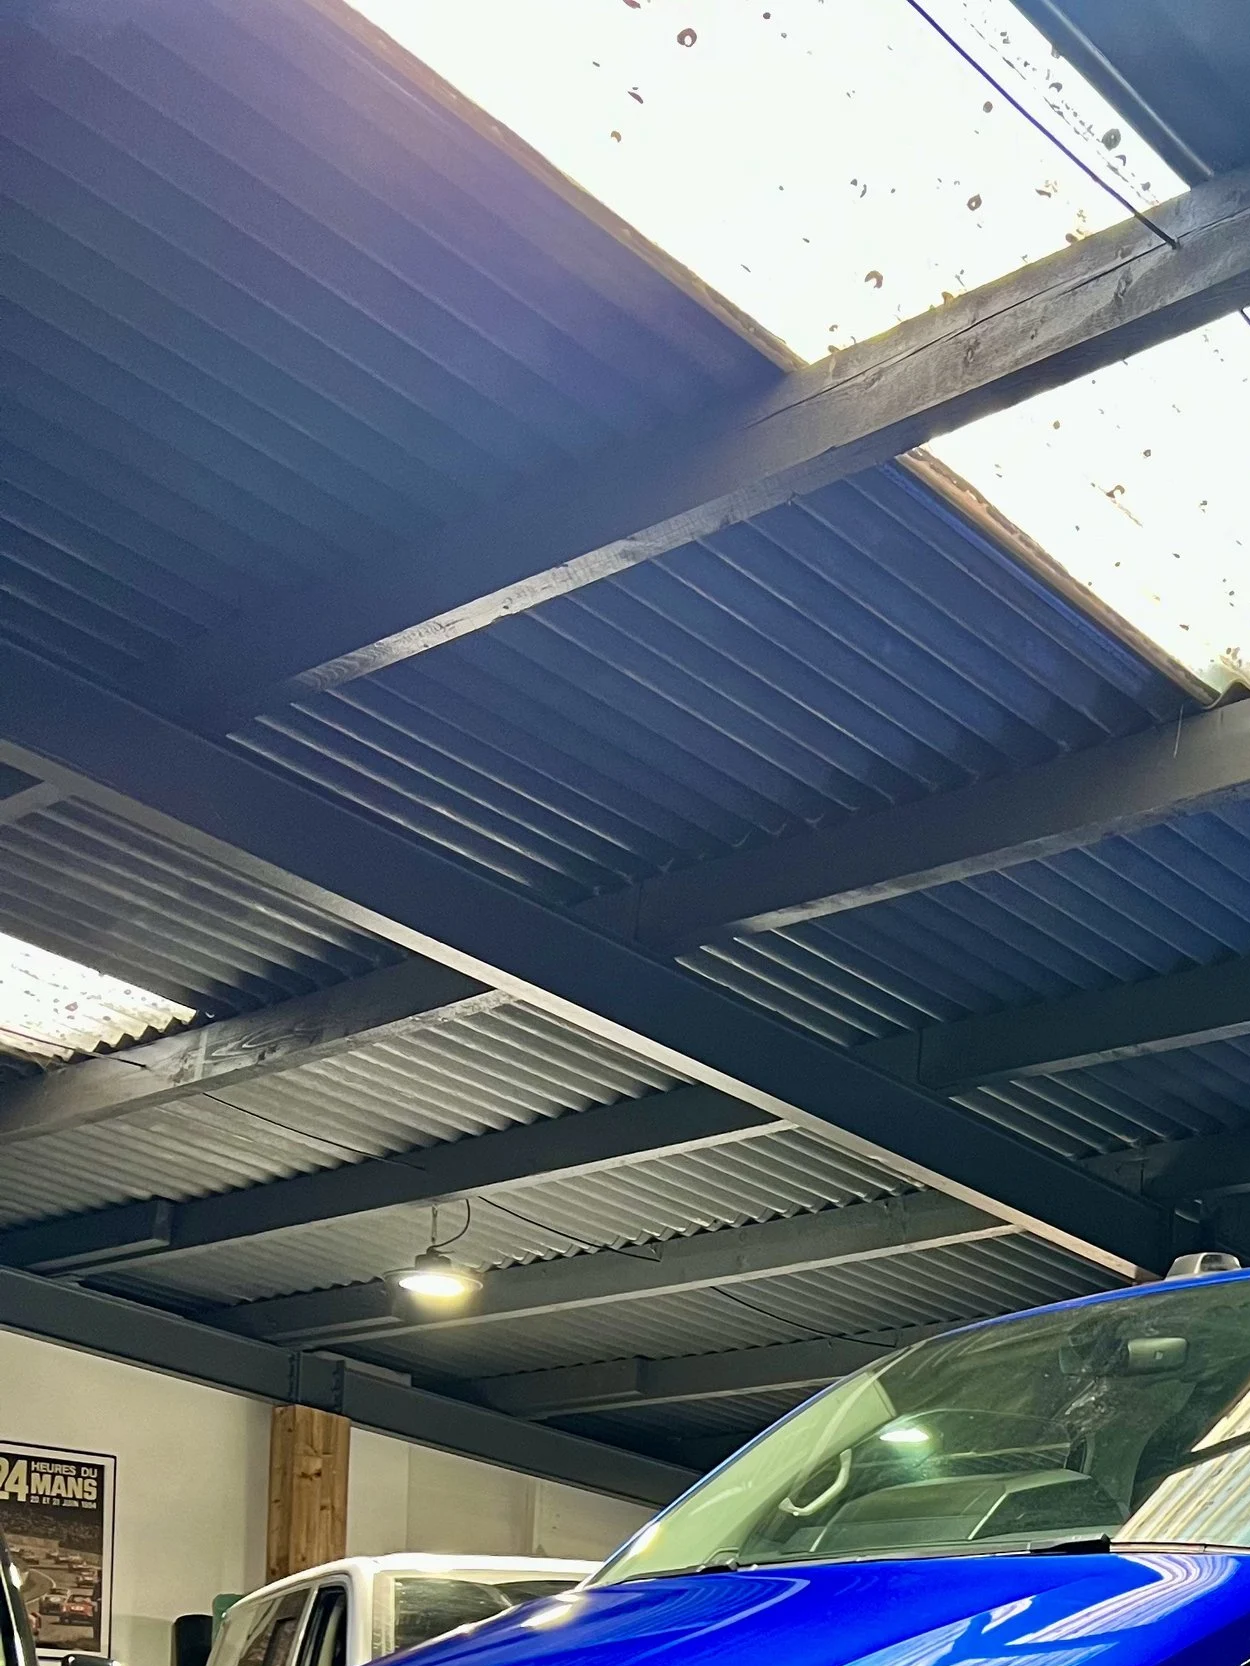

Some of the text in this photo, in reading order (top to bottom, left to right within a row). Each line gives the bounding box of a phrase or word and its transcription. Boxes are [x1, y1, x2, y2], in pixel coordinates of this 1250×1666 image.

[31, 1461, 97, 1478] HEURES DU
[30, 1472, 98, 1501] MANS
